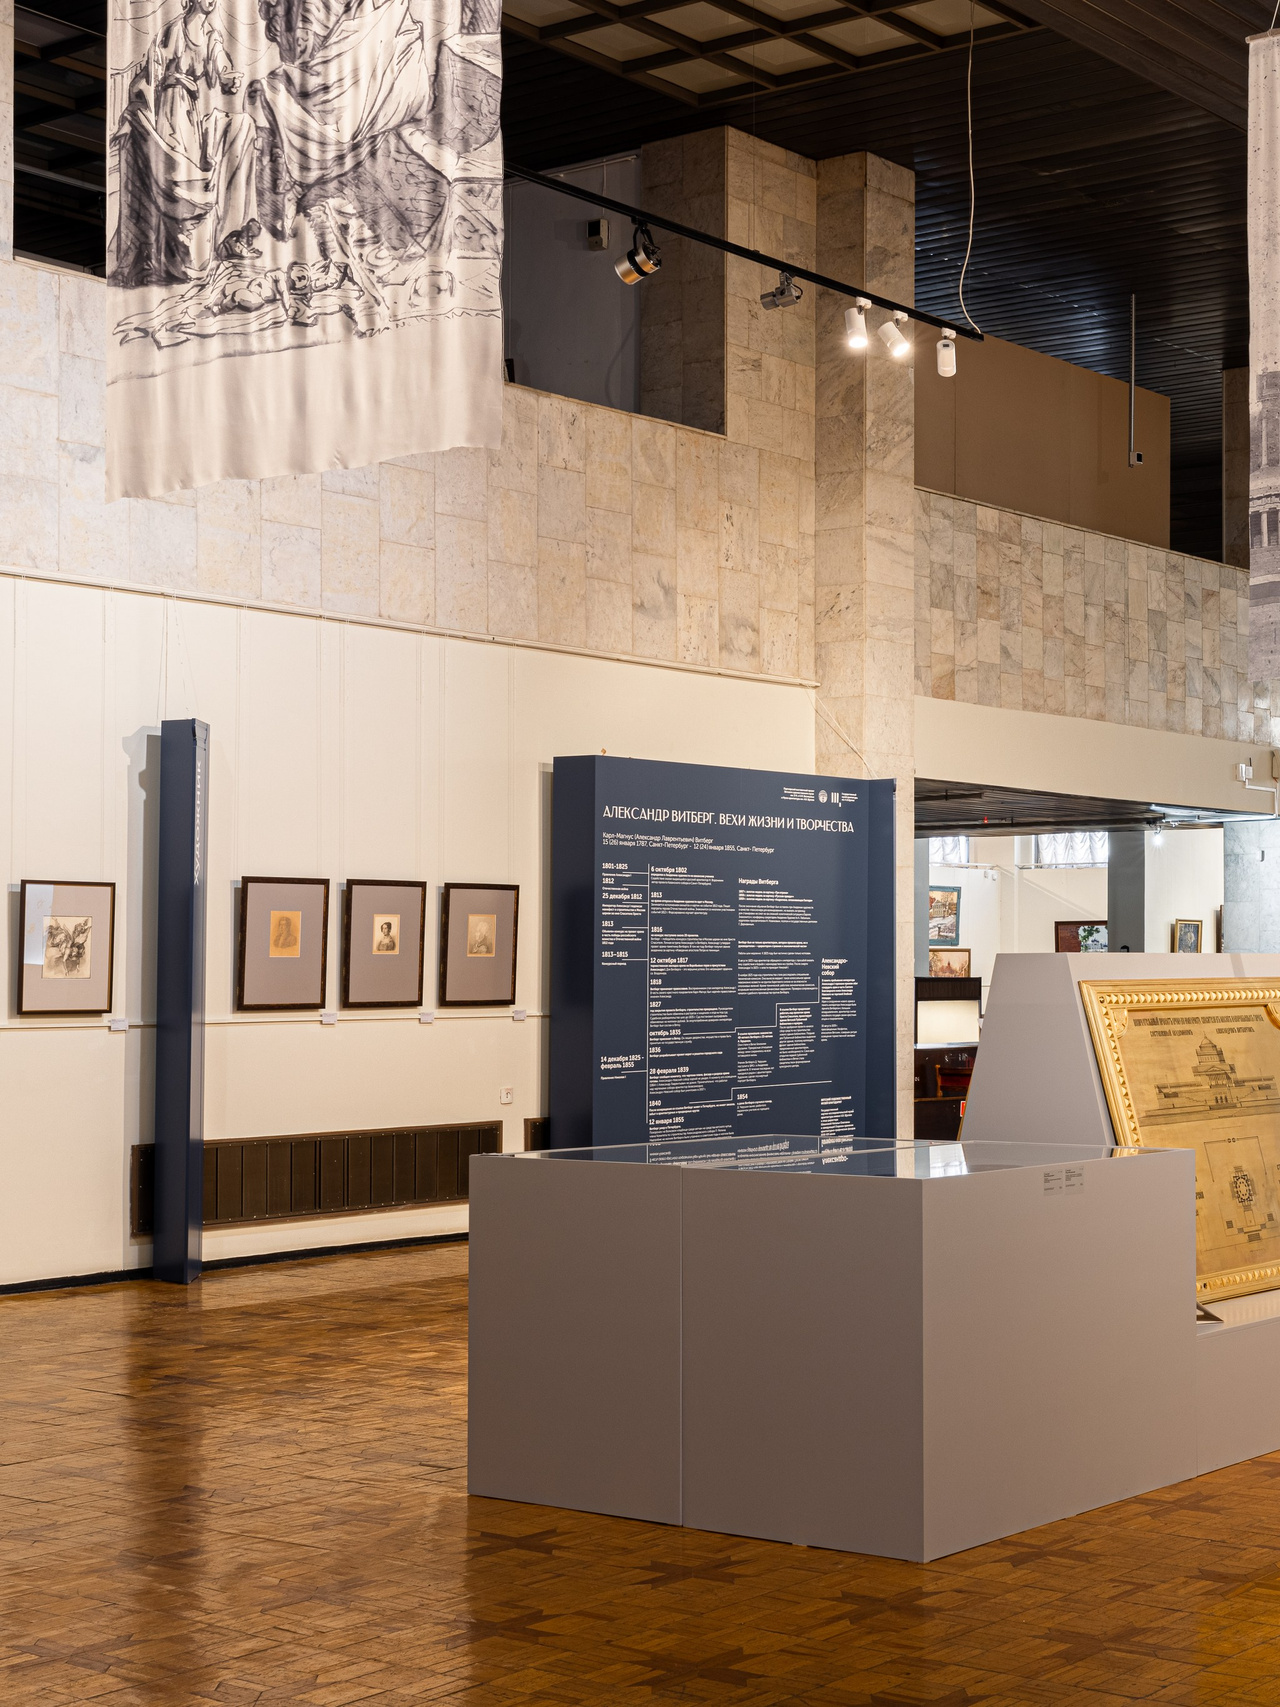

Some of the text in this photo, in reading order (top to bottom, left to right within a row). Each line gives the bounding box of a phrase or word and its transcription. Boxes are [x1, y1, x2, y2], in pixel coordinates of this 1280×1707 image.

[603, 806, 854, 833] АЛЕКСАНДР ВИТБЕРГ. ВЕХИ ЖИЗНИ И ТВОРЧЕСТВА
